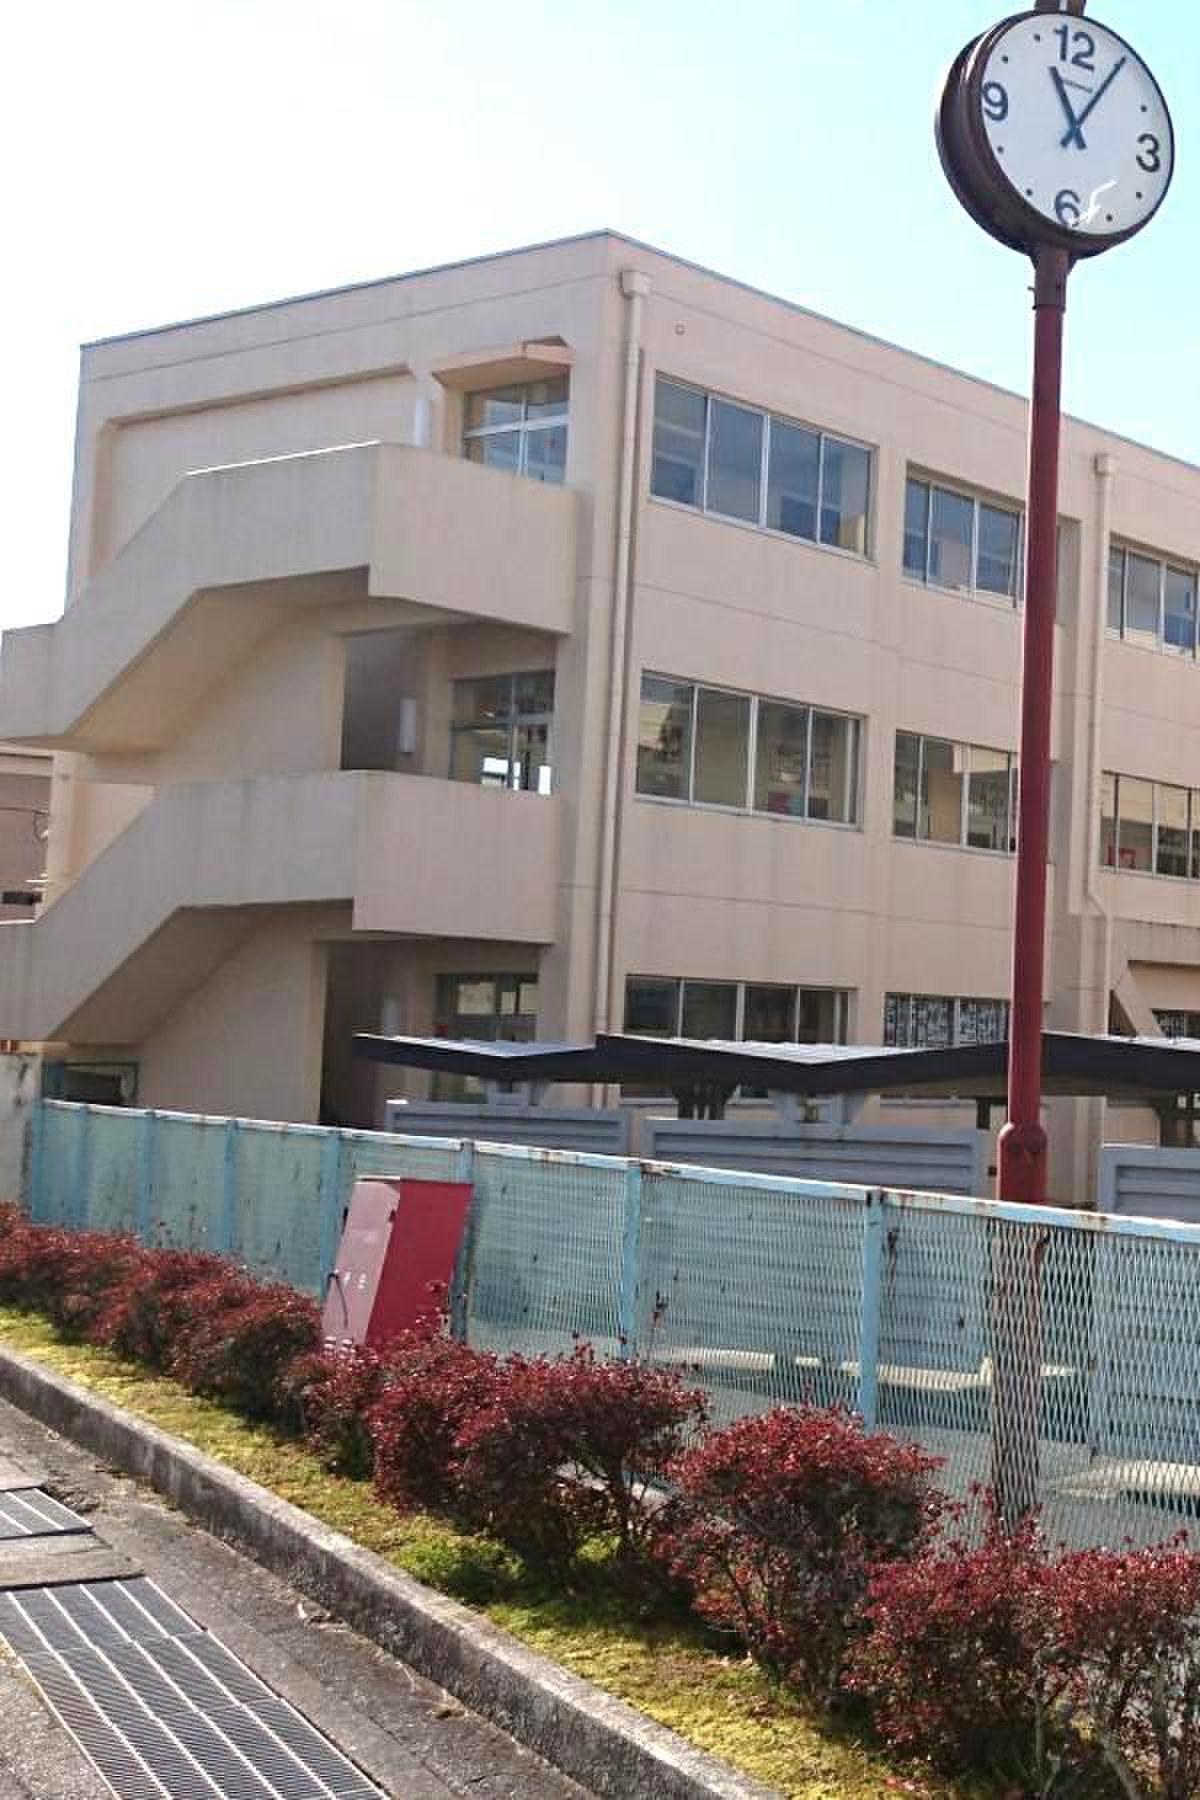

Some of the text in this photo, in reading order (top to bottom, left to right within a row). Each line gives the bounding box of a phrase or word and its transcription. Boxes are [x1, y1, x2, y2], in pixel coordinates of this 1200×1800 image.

[1053, 24, 1096, 71] 12
[982, 81, 1009, 121] 9
[1136, 133, 1161, 173] 3
[1054, 189, 1081, 227] 6
